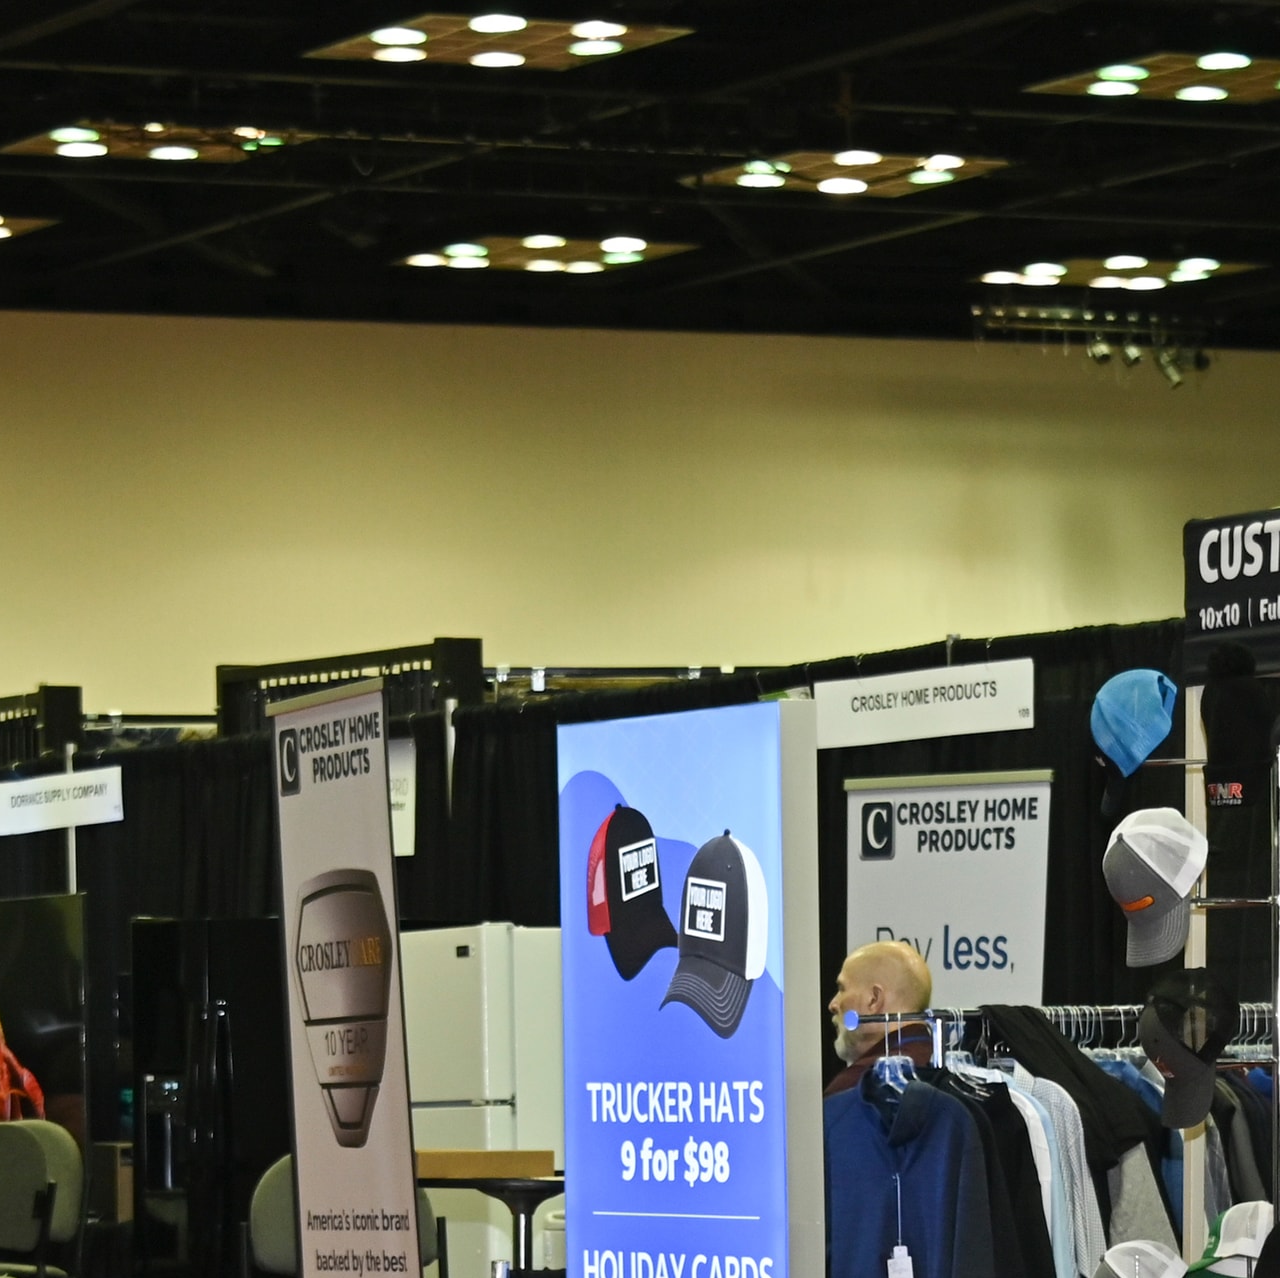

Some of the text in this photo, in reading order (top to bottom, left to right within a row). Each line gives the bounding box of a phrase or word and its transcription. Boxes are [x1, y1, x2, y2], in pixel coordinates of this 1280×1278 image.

[1199, 603, 1240, 631] 10x10
[851, 680, 997, 713] CROSLEY HOME PRODUCTS
[299, 712, 380, 754] CROSLEY HOME
[312, 747, 371, 784] PRODUCTS
[44, 787, 73, 804] SUPPLY
[73, 783, 108, 800] COMPANY
[897, 797, 1039, 826] CROSLEY HOME
[917, 827, 1016, 853] PRODUCTS
[631, 867, 649, 891] HERE
[696, 909, 714, 932] HERE
[943, 925, 1015, 974] less,
[325, 1030, 337, 1057] 10
[586, 1080, 765, 1123] TRUCKER HATS
[621, 1136, 730, 1187] 9 for $98
[307, 1209, 410, 1232] America's iconic brand
[316, 1249, 408, 1278] backed by the best
